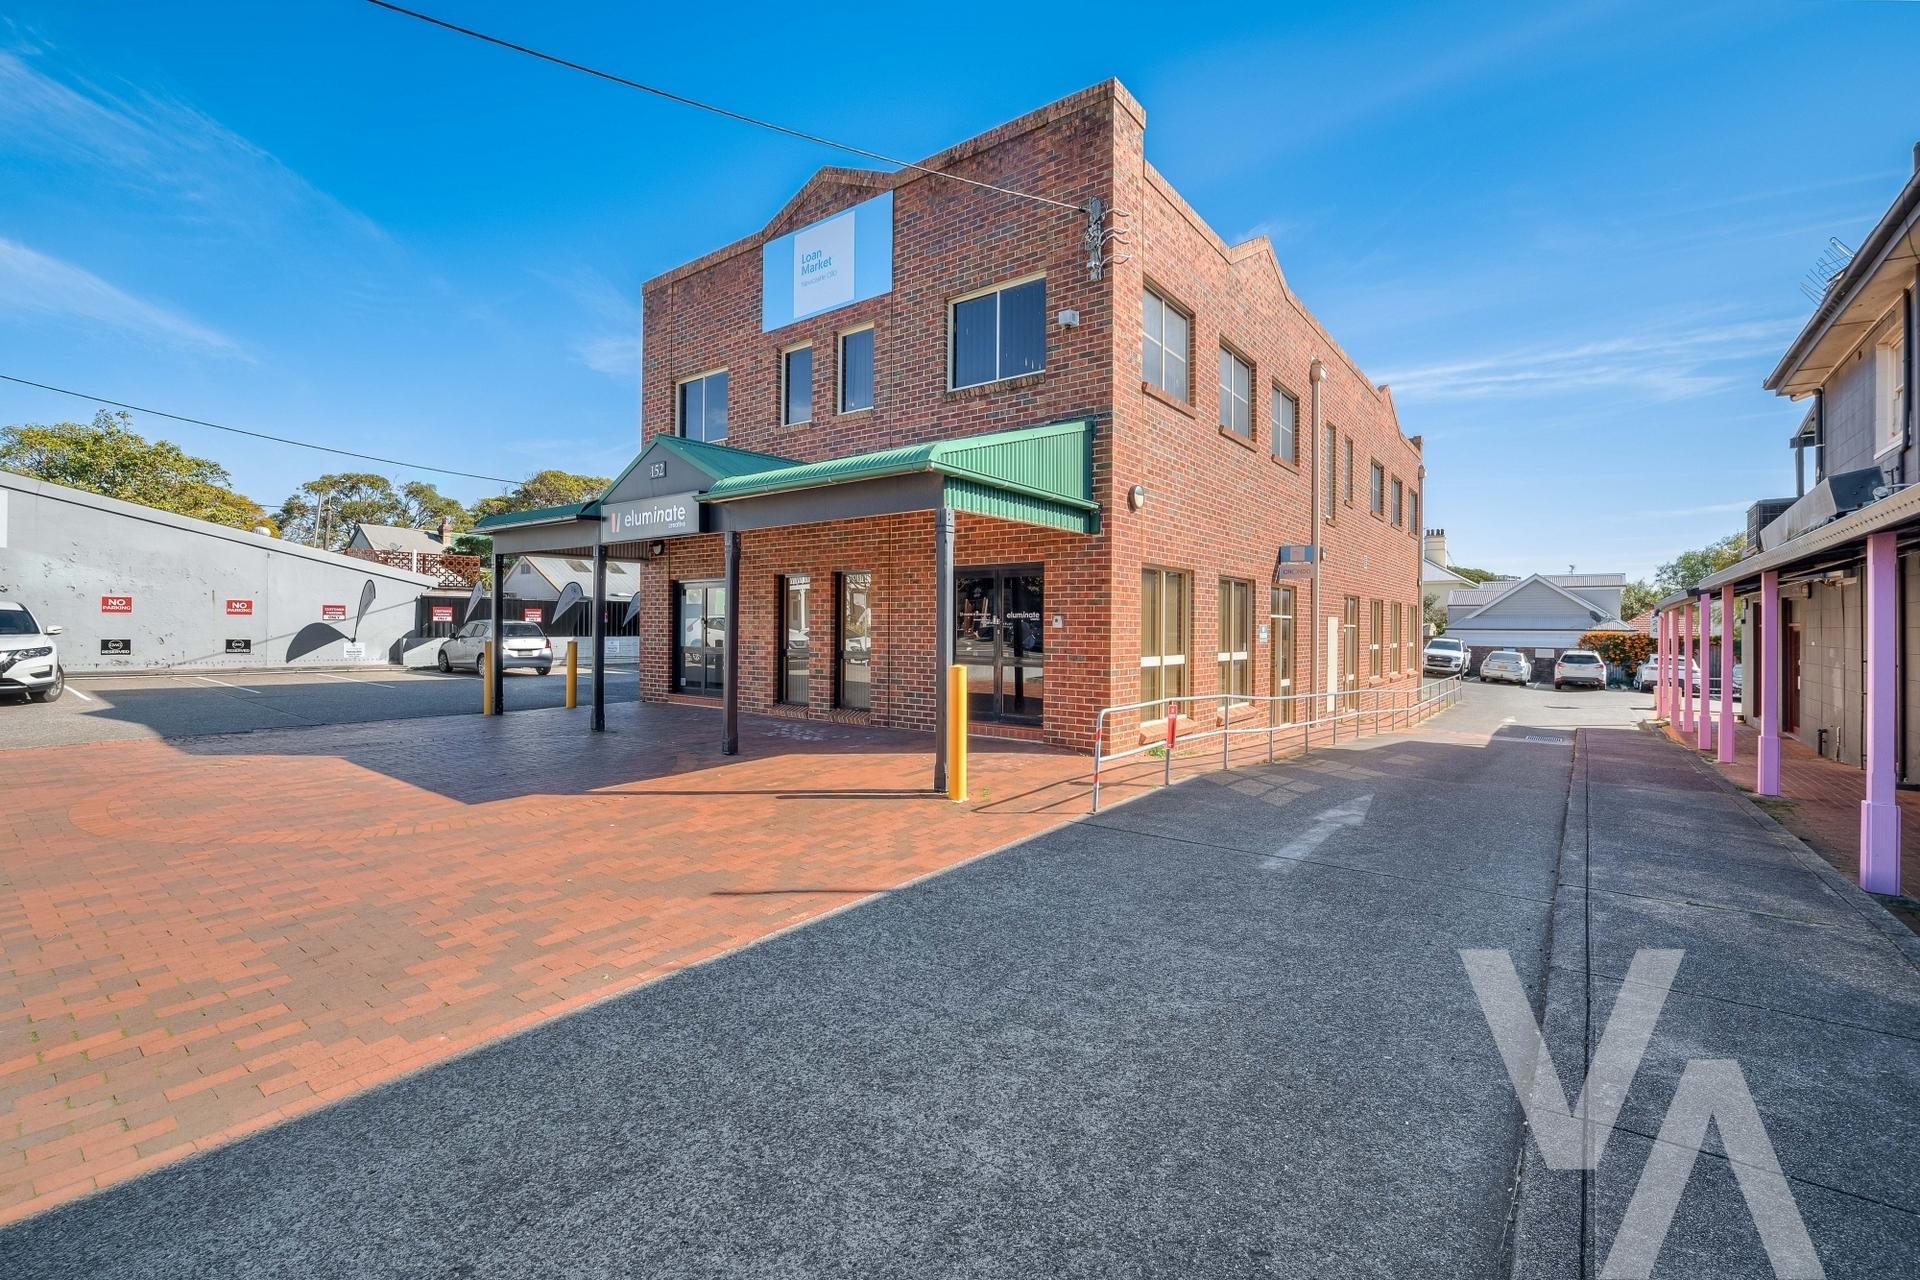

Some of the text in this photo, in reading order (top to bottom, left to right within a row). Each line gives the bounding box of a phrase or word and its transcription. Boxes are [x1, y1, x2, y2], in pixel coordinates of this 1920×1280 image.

[801, 250, 822, 264] Loan
[801, 256, 832, 276] Market
[649, 463, 664, 477] 152
[624, 505, 686, 527] eluminate
[1006, 610, 1040, 619] eluminate
